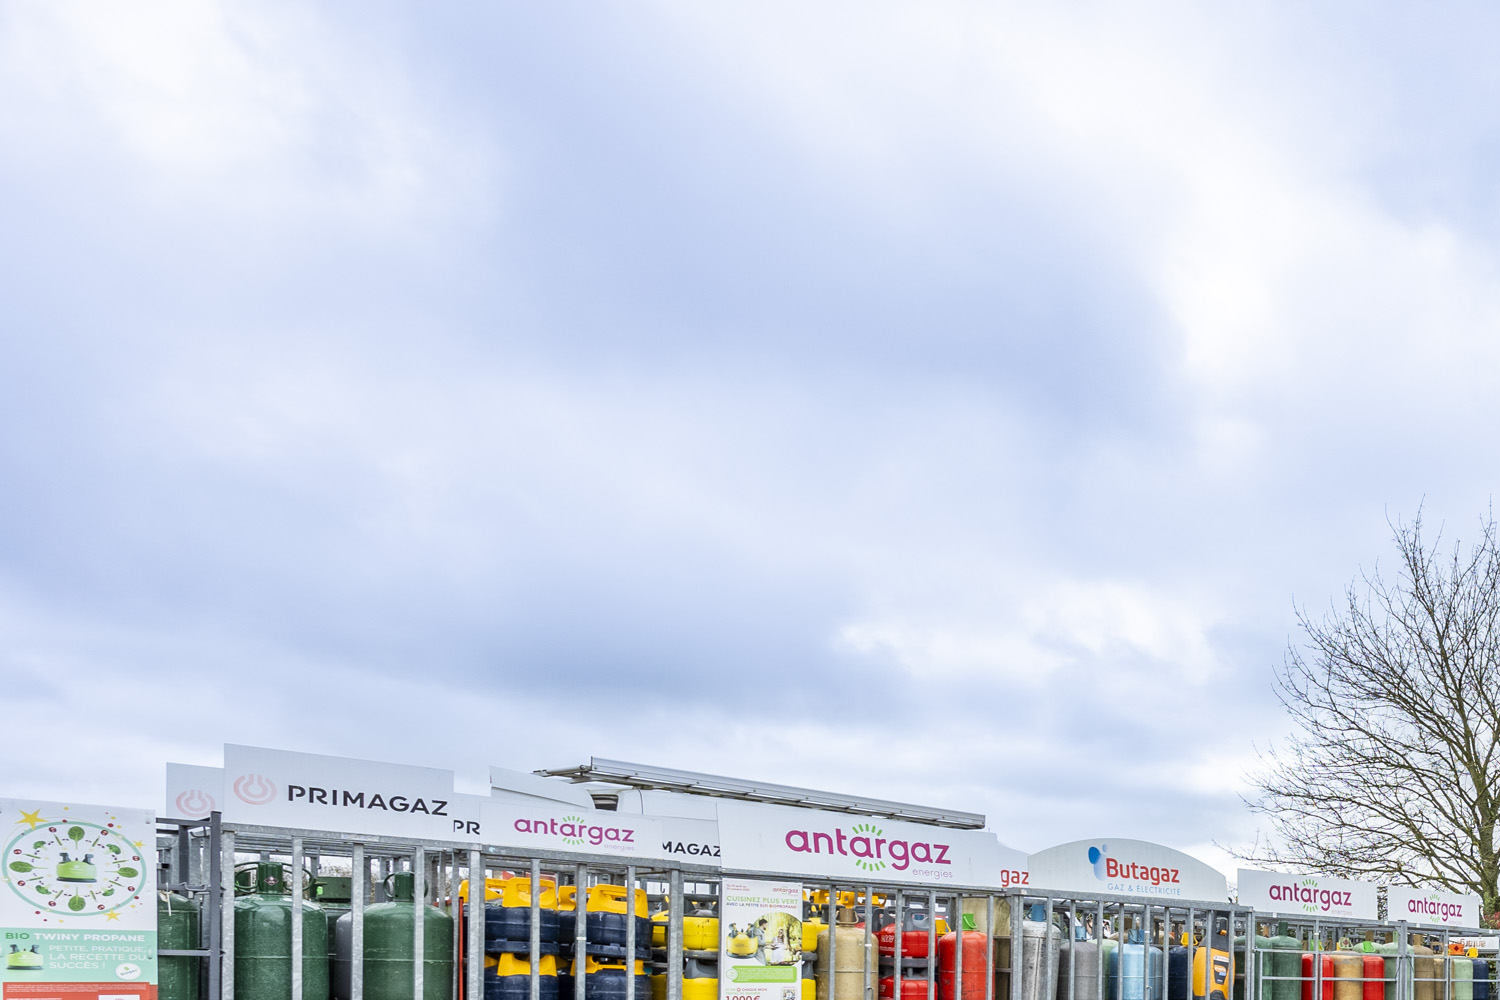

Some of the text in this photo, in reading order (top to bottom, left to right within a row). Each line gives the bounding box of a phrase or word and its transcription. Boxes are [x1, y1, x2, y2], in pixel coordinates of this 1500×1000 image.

[288, 784, 448, 816] PRIMAGAZ
[514, 817, 635, 846] antargaz
[662, 841, 721, 857] MAGAZ
[785, 827, 952, 871] antargaz
[912, 868, 953, 880] energies
[1106, 857, 1180, 886] Butagaz
[1107, 882, 1125, 892] GAZ
[1128, 884, 1134, 892] &
[1269, 882, 1352, 912] antargaz
[1408, 897, 1462, 922] antargaz
[84, 934, 144, 942] PROPANE
